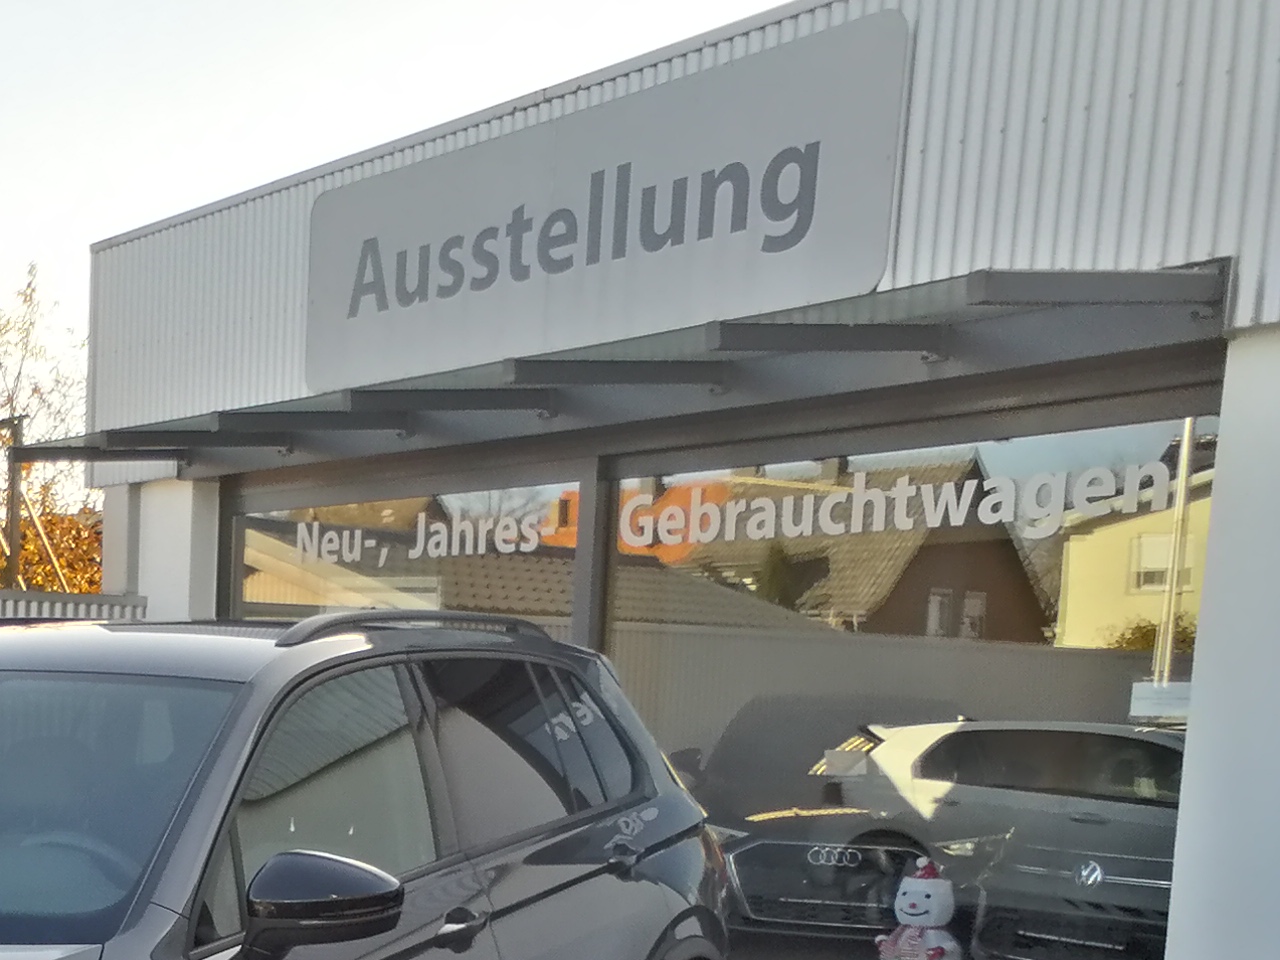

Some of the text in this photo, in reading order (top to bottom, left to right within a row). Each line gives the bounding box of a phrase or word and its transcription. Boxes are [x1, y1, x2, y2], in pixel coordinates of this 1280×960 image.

[346, 140, 821, 320] Ausstellung
[294, 460, 1171, 568] Neu-, Jahres- Gebrauchtwagen
